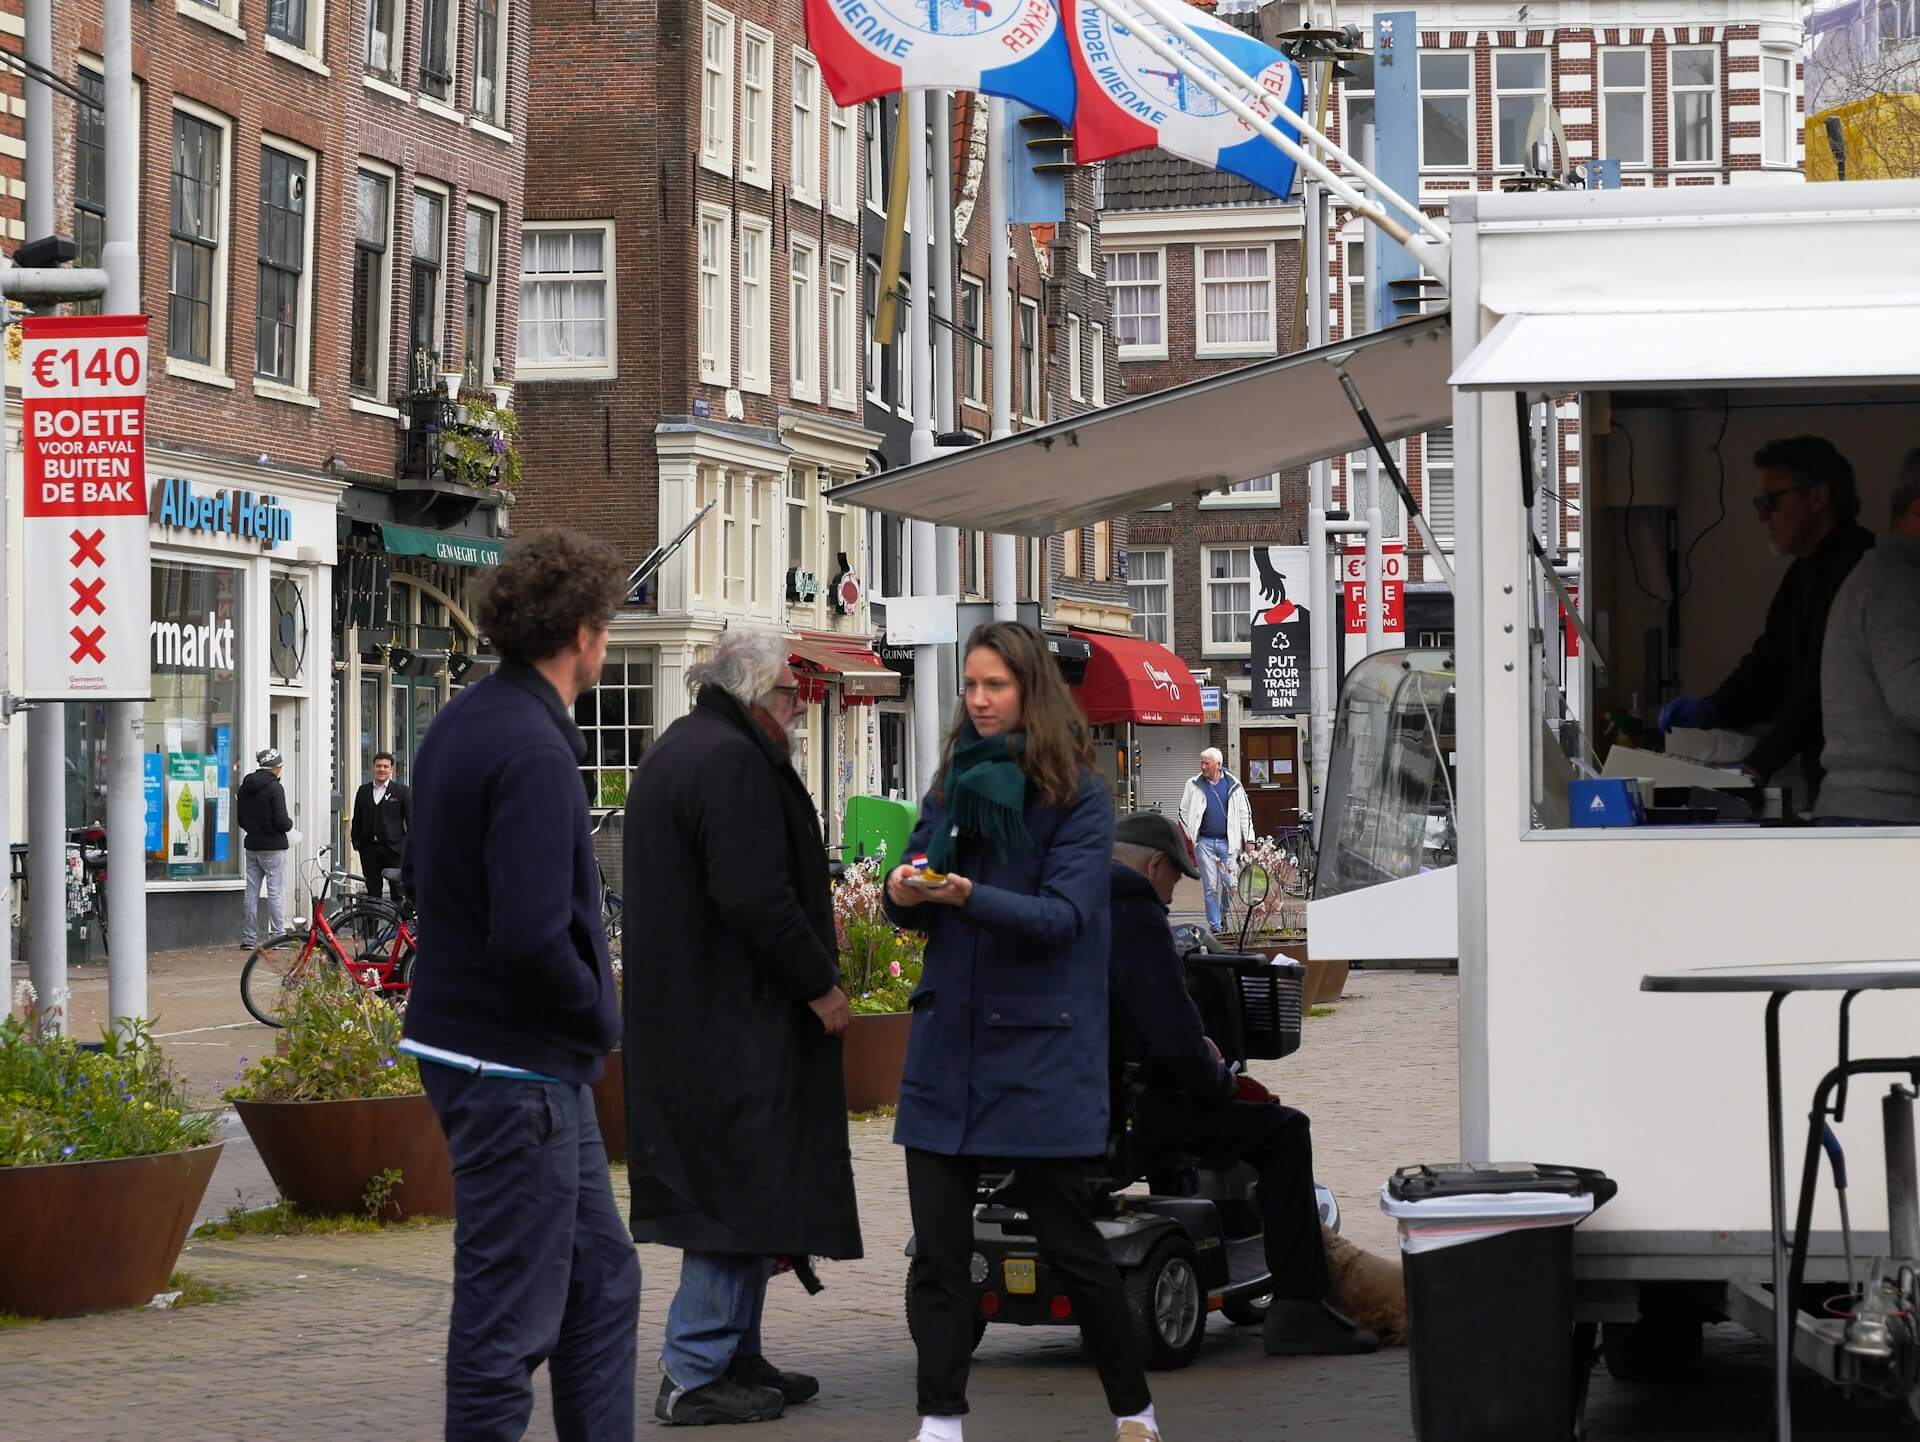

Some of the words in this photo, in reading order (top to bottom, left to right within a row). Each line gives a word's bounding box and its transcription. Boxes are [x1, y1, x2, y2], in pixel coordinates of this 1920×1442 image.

[32, 347, 140, 388] €140
[34, 409, 140, 438] BOETE
[39, 442, 83, 455] VOOR
[87, 441, 136, 454] AFVAL
[44, 458, 130, 478] BUITEN
[42, 483, 75, 503] DE
[82, 482, 134, 502] BAK
[159, 479, 232, 535] Albert
[239, 490, 292, 551] Heijn
[1352, 585, 1396, 602] FIE
[1358, 603, 1390, 617] FR
[1351, 618, 1398, 627] LITNG
[882, 648, 915, 660] GUINNE
[1268, 655, 1297, 668] PUT
[1264, 668, 1299, 678] YOUR
[1263, 679, 1300, 689] TRASH
[1267, 689, 1278, 697] IN
[1280, 689, 1298, 697] THE
[1272, 697, 1293, 708] BIN
